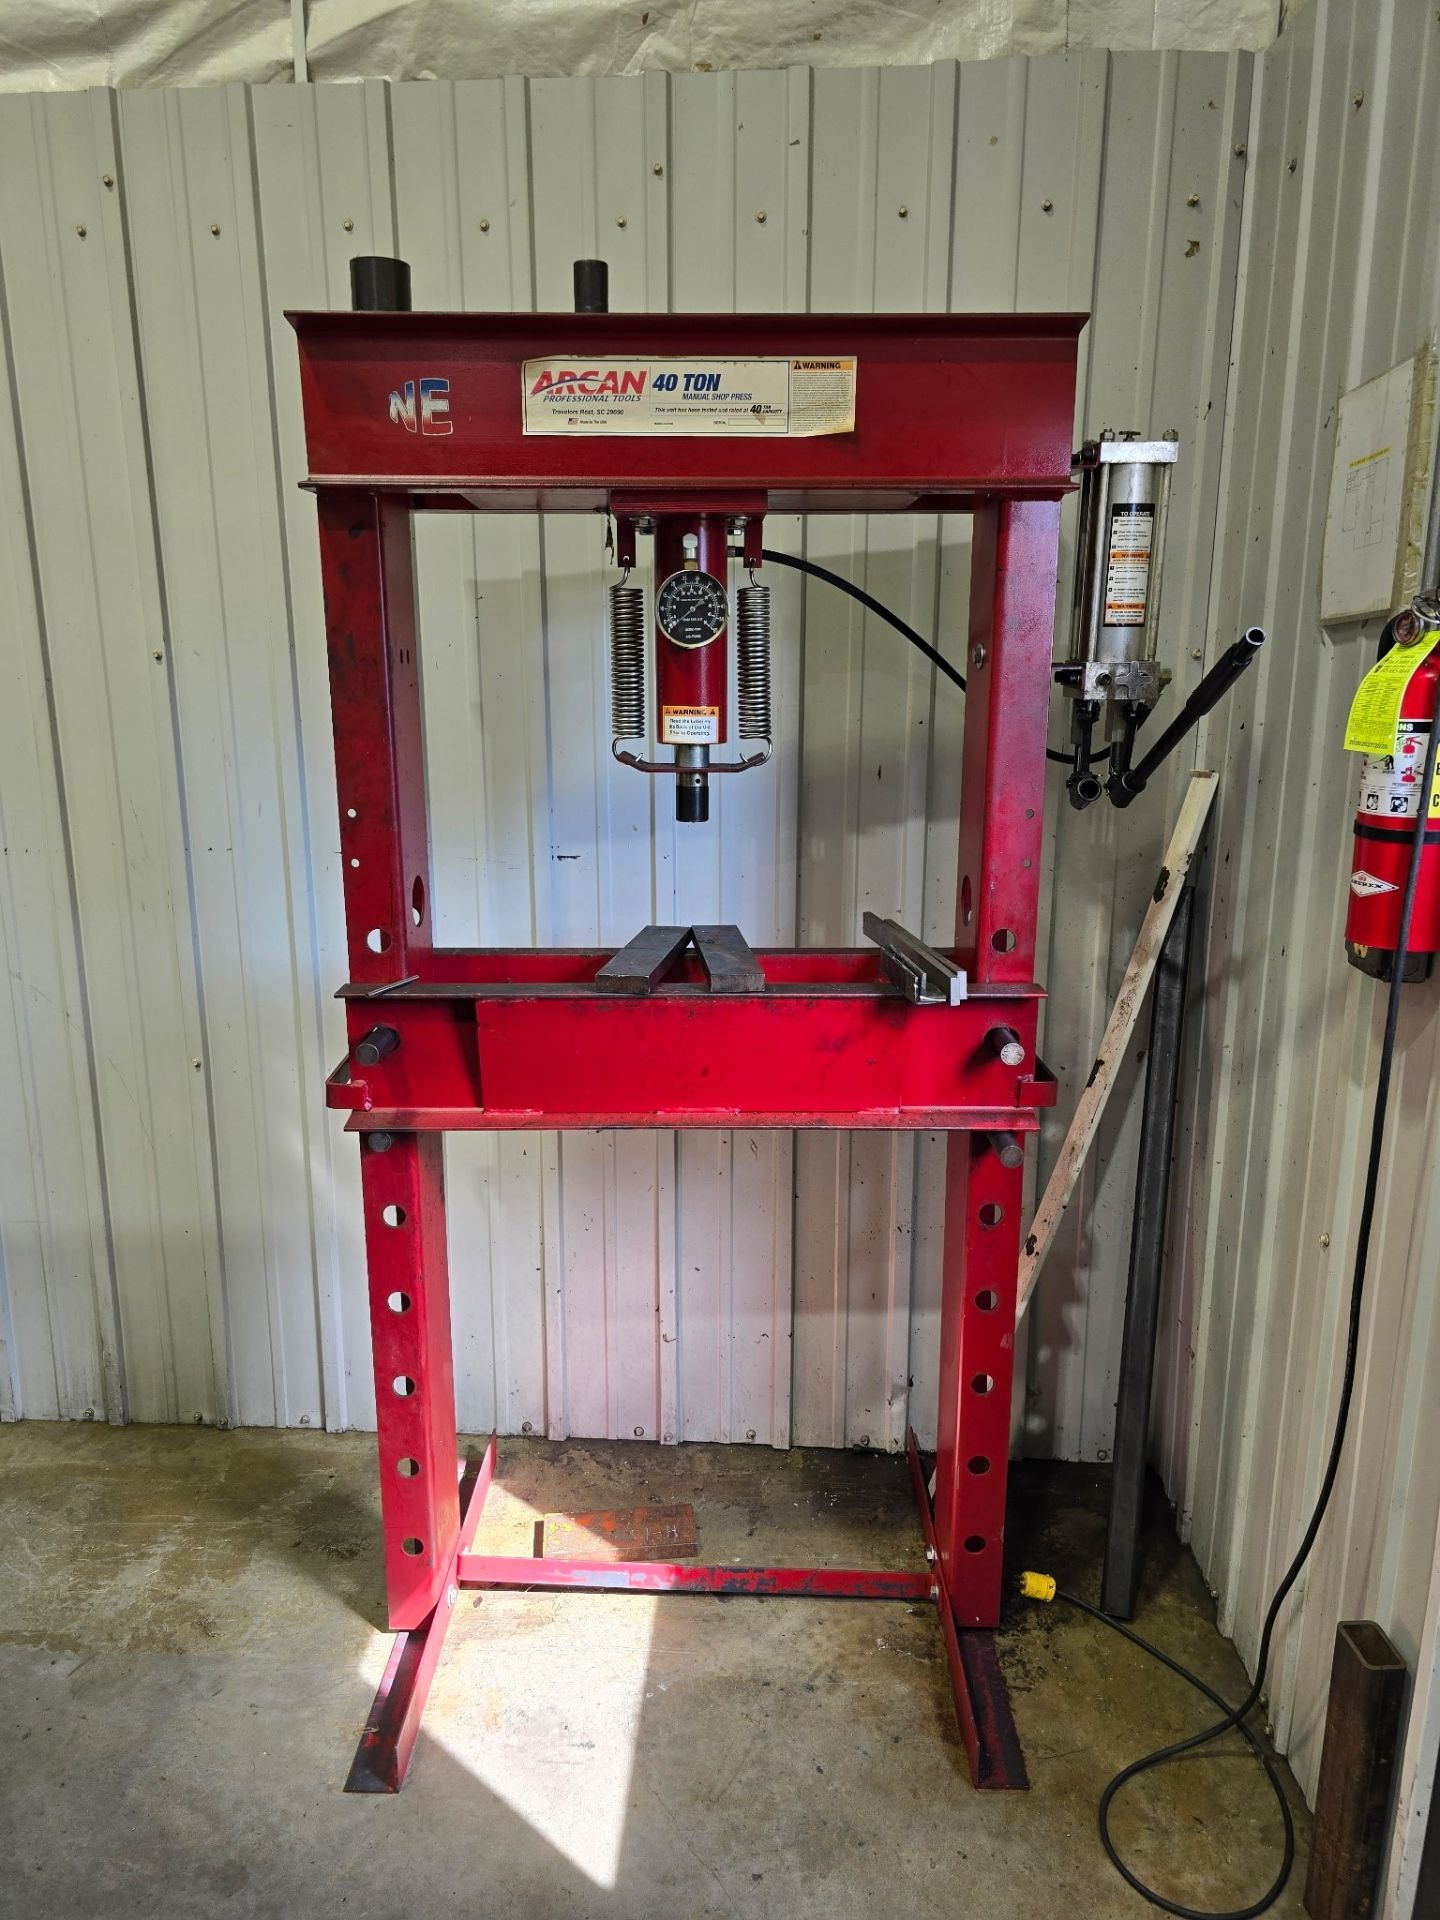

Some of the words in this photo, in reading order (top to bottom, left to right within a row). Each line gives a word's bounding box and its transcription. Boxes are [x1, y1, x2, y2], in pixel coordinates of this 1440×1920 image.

[530, 370, 648, 397] ARCAN
[652, 373, 679, 391] 40
[683, 373, 721, 391] TON
[389, 377, 453, 436] NE
[543, 394, 609, 402] PROFESSIONAL
[613, 394, 642, 402] TOOLS
[750, 404, 762, 414] 40
